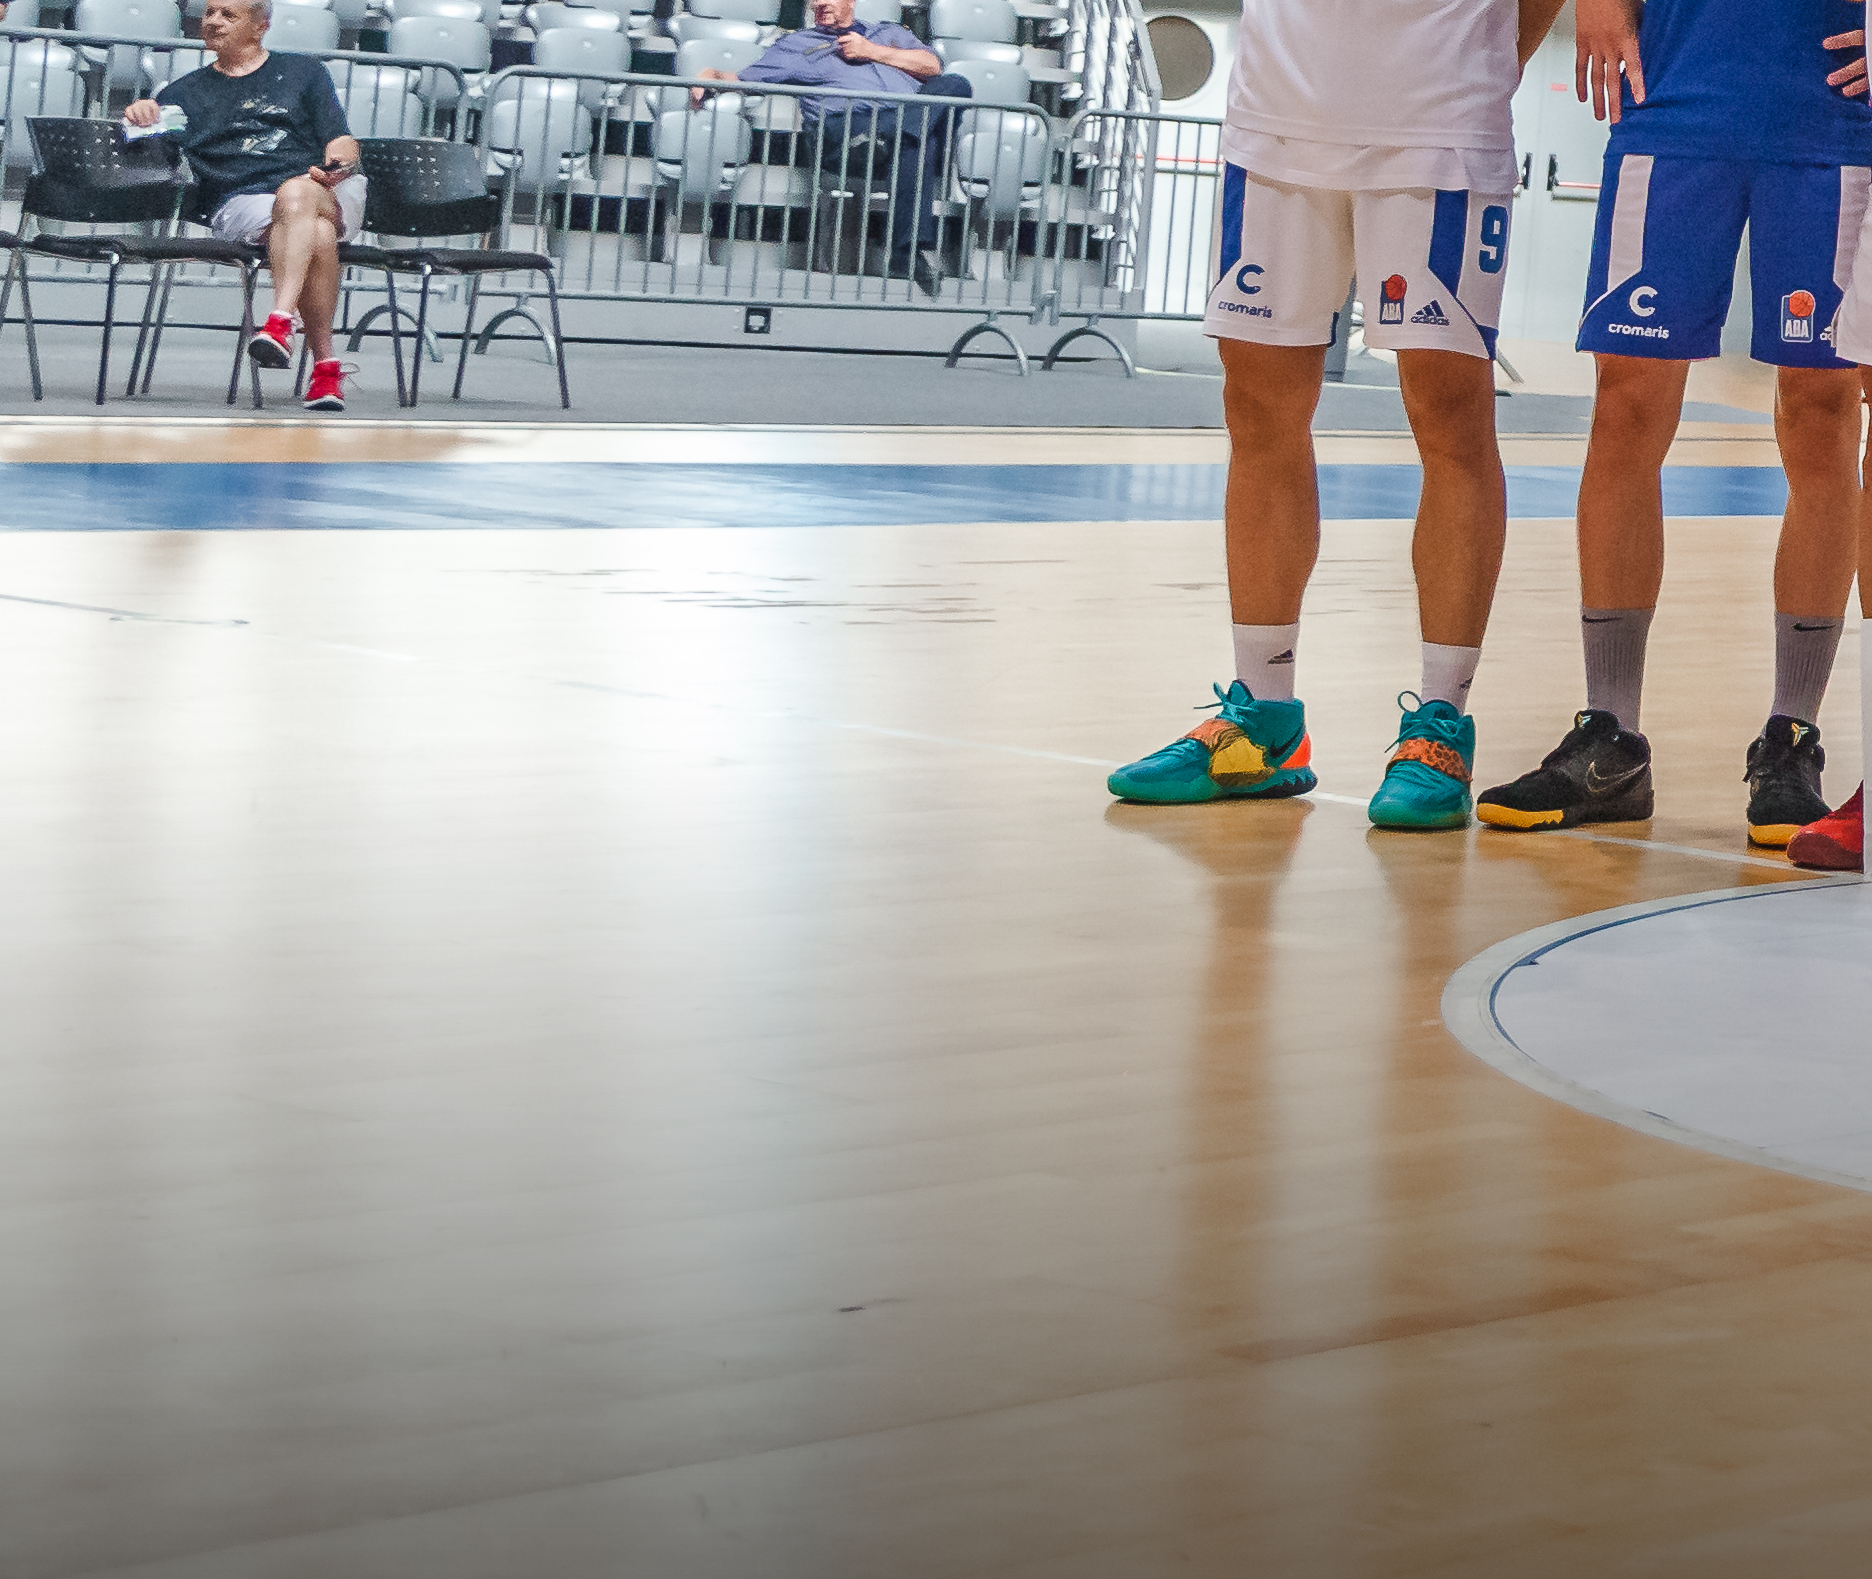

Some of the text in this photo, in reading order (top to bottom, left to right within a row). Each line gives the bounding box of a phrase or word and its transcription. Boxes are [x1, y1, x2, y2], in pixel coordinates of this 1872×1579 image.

[1478, 205, 1509, 275] 9
[1217, 299, 1273, 319] cromaris
[1608, 321, 1670, 340] cromaris
